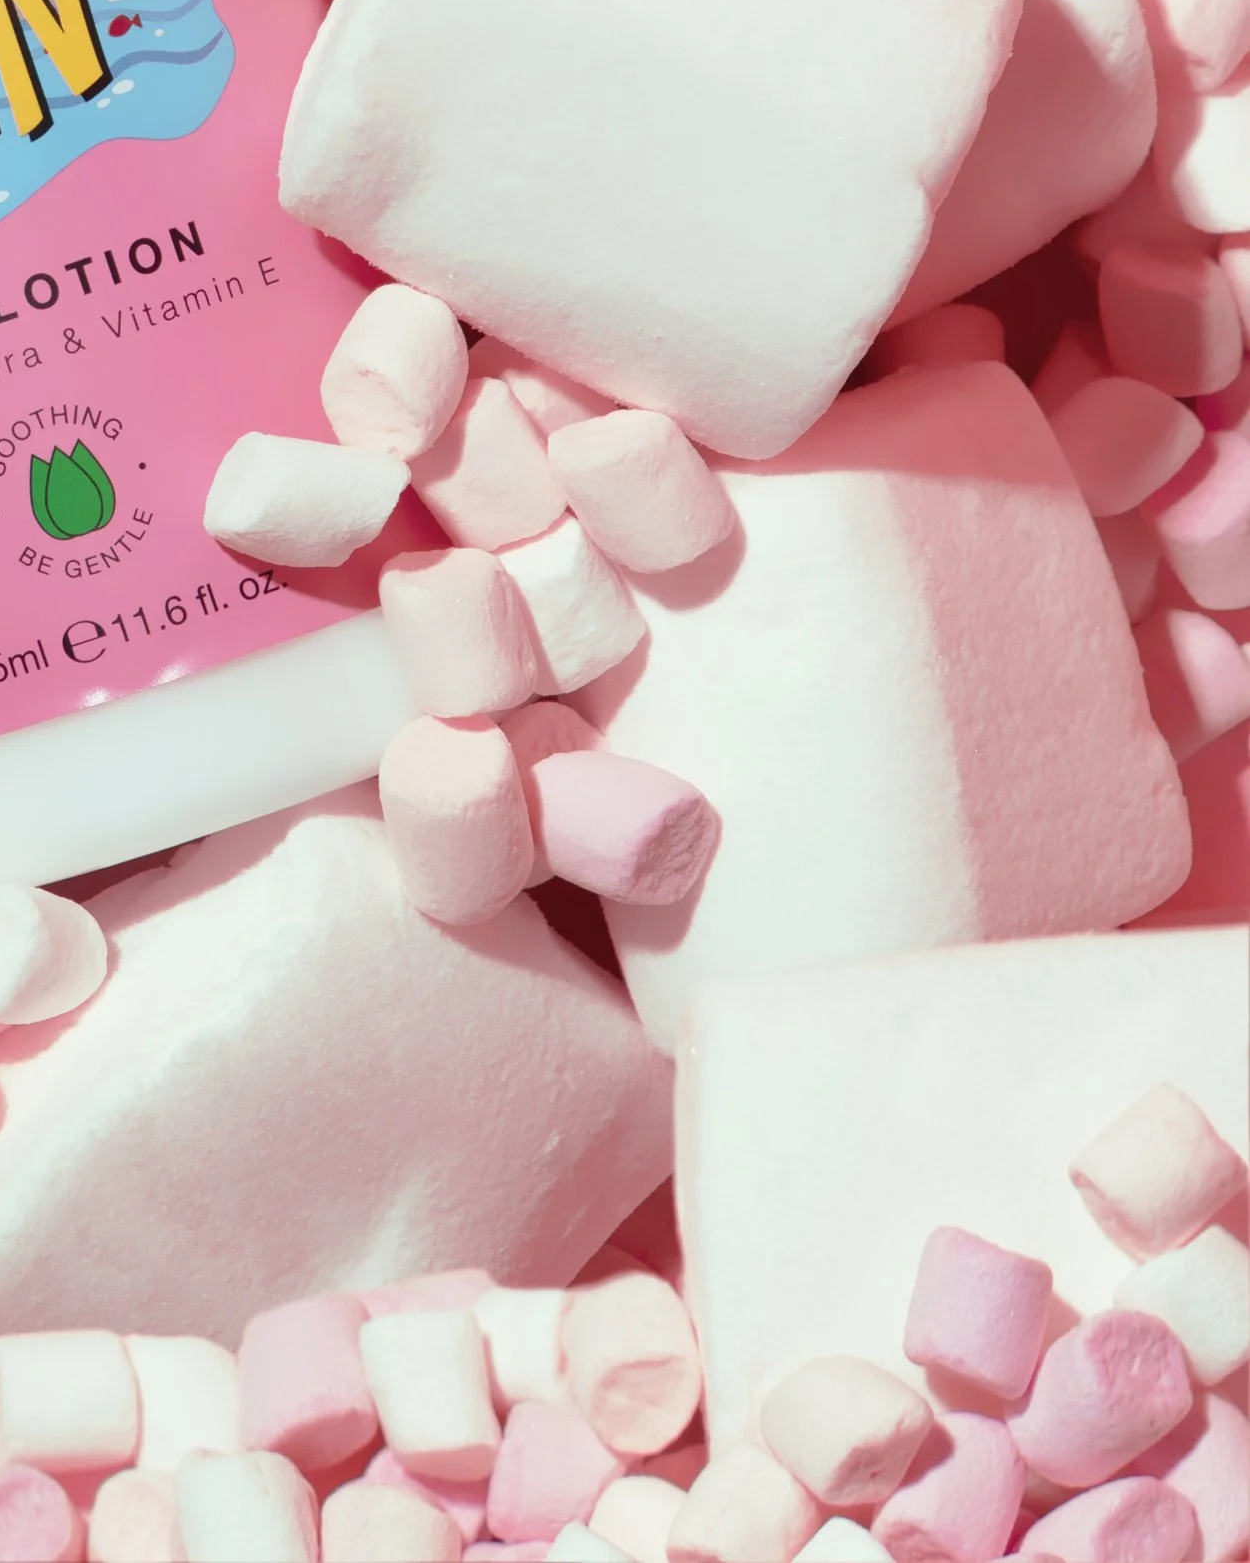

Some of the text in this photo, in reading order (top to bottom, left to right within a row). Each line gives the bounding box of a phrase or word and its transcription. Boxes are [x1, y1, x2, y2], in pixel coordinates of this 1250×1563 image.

[63, 327, 86, 355] &
[101, 276, 245, 340] Vitamin
[258, 256, 281, 286] E
[18, 507, 154, 579] BE GENTLE
[195, 583, 229, 617] fl.
[238, 568, 289, 602] oz.
